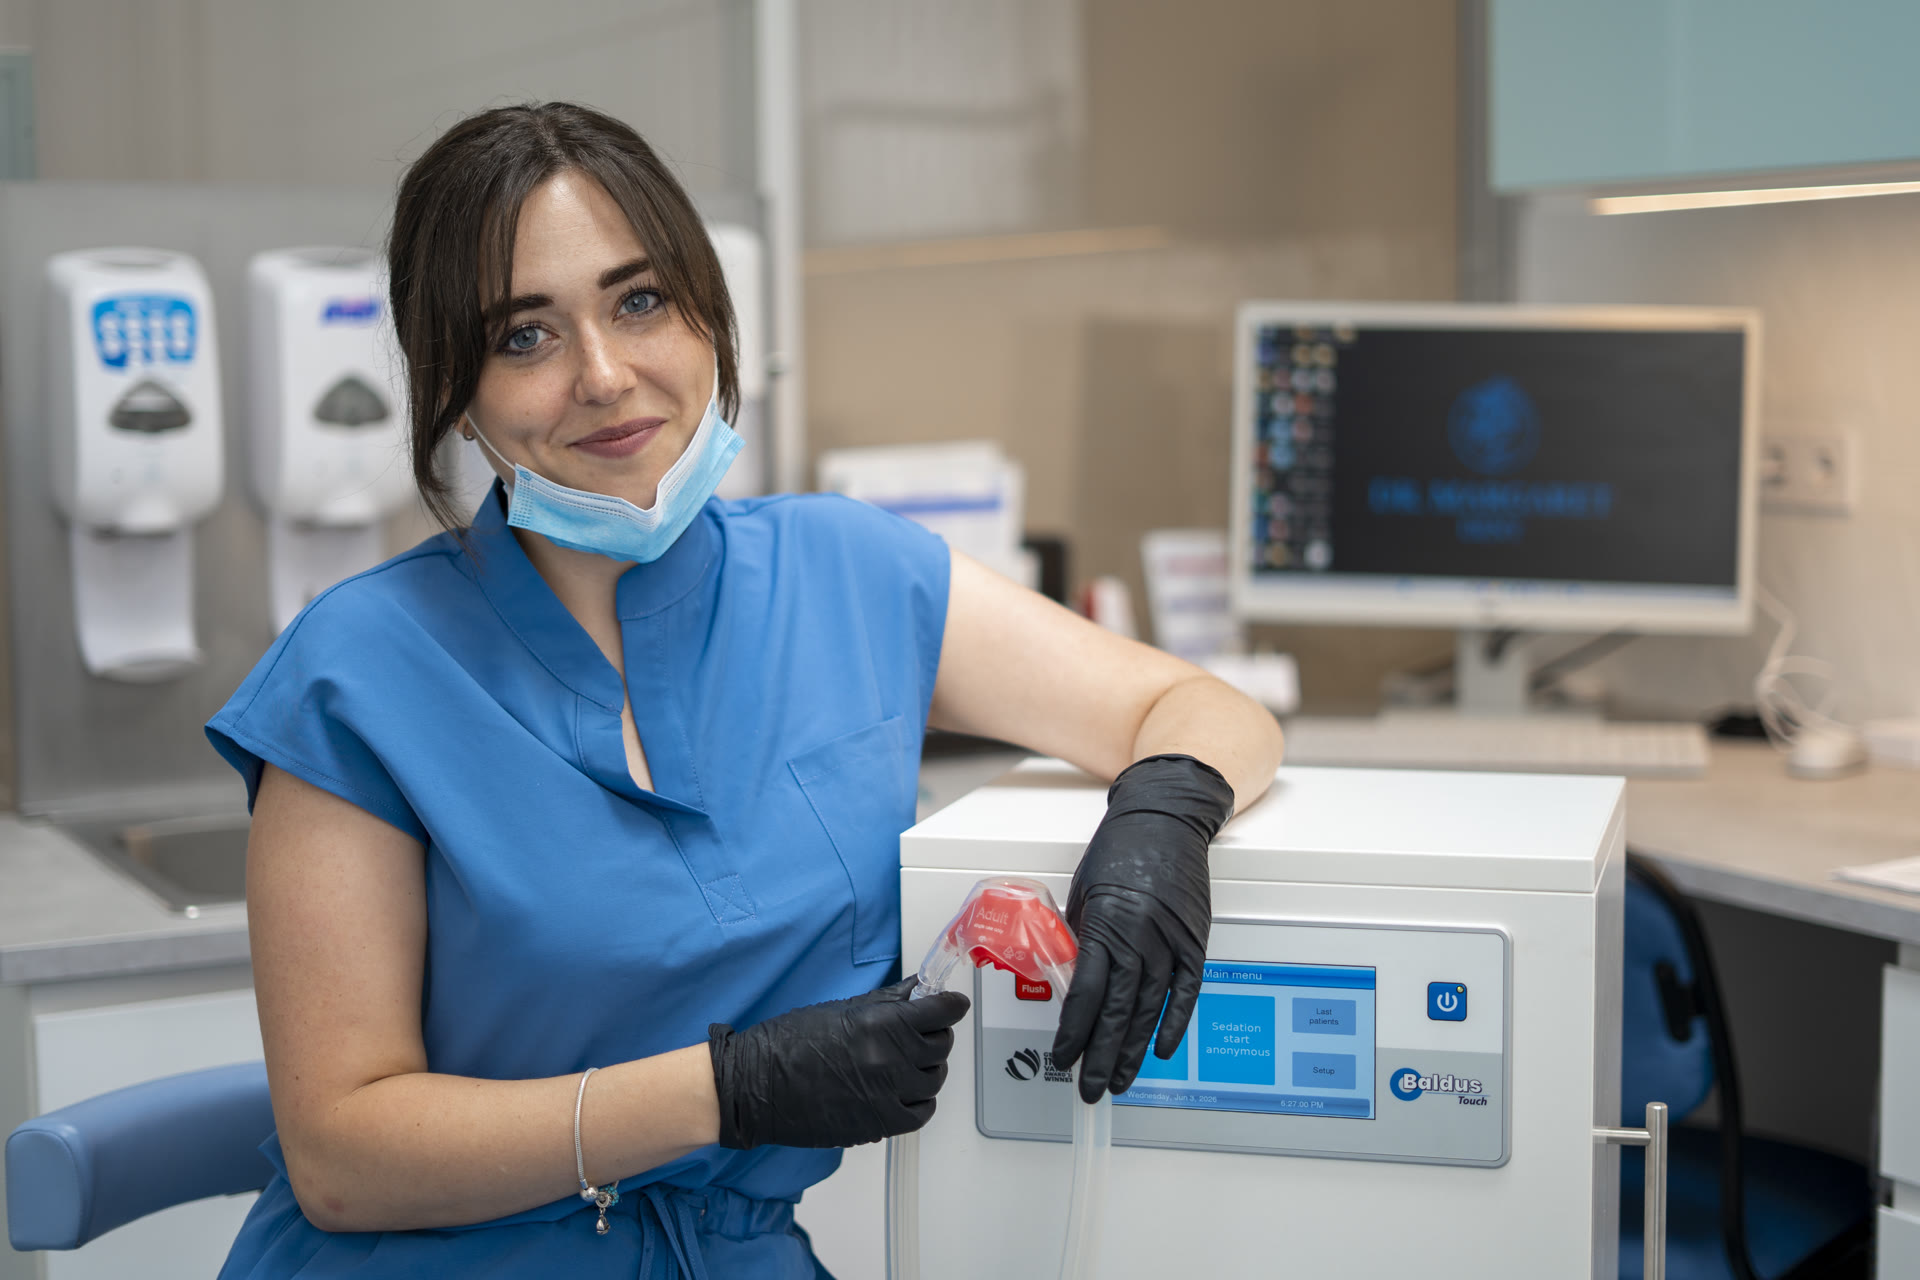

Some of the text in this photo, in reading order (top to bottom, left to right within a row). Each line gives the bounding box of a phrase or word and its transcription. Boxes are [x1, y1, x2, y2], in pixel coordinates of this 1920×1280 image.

[976, 906, 1009, 925] Adult
[1203, 968, 1262, 981] Main menu
[1022, 984, 1046, 994] Flush
[1316, 1008, 1332, 1016] Last
[1212, 1022, 1261, 1033] Sedation
[1309, 1018, 1339, 1027] patients
[1223, 1034, 1250, 1044] start
[1206, 1046, 1271, 1058] anonymous
[1313, 1066, 1335, 1075] Setup
[1403, 1073, 1482, 1093] Baldus
[1127, 1091, 1172, 1101] Wednesday,
[1458, 1096, 1488, 1106] Touch
[1311, 1101, 1324, 1109] PM
